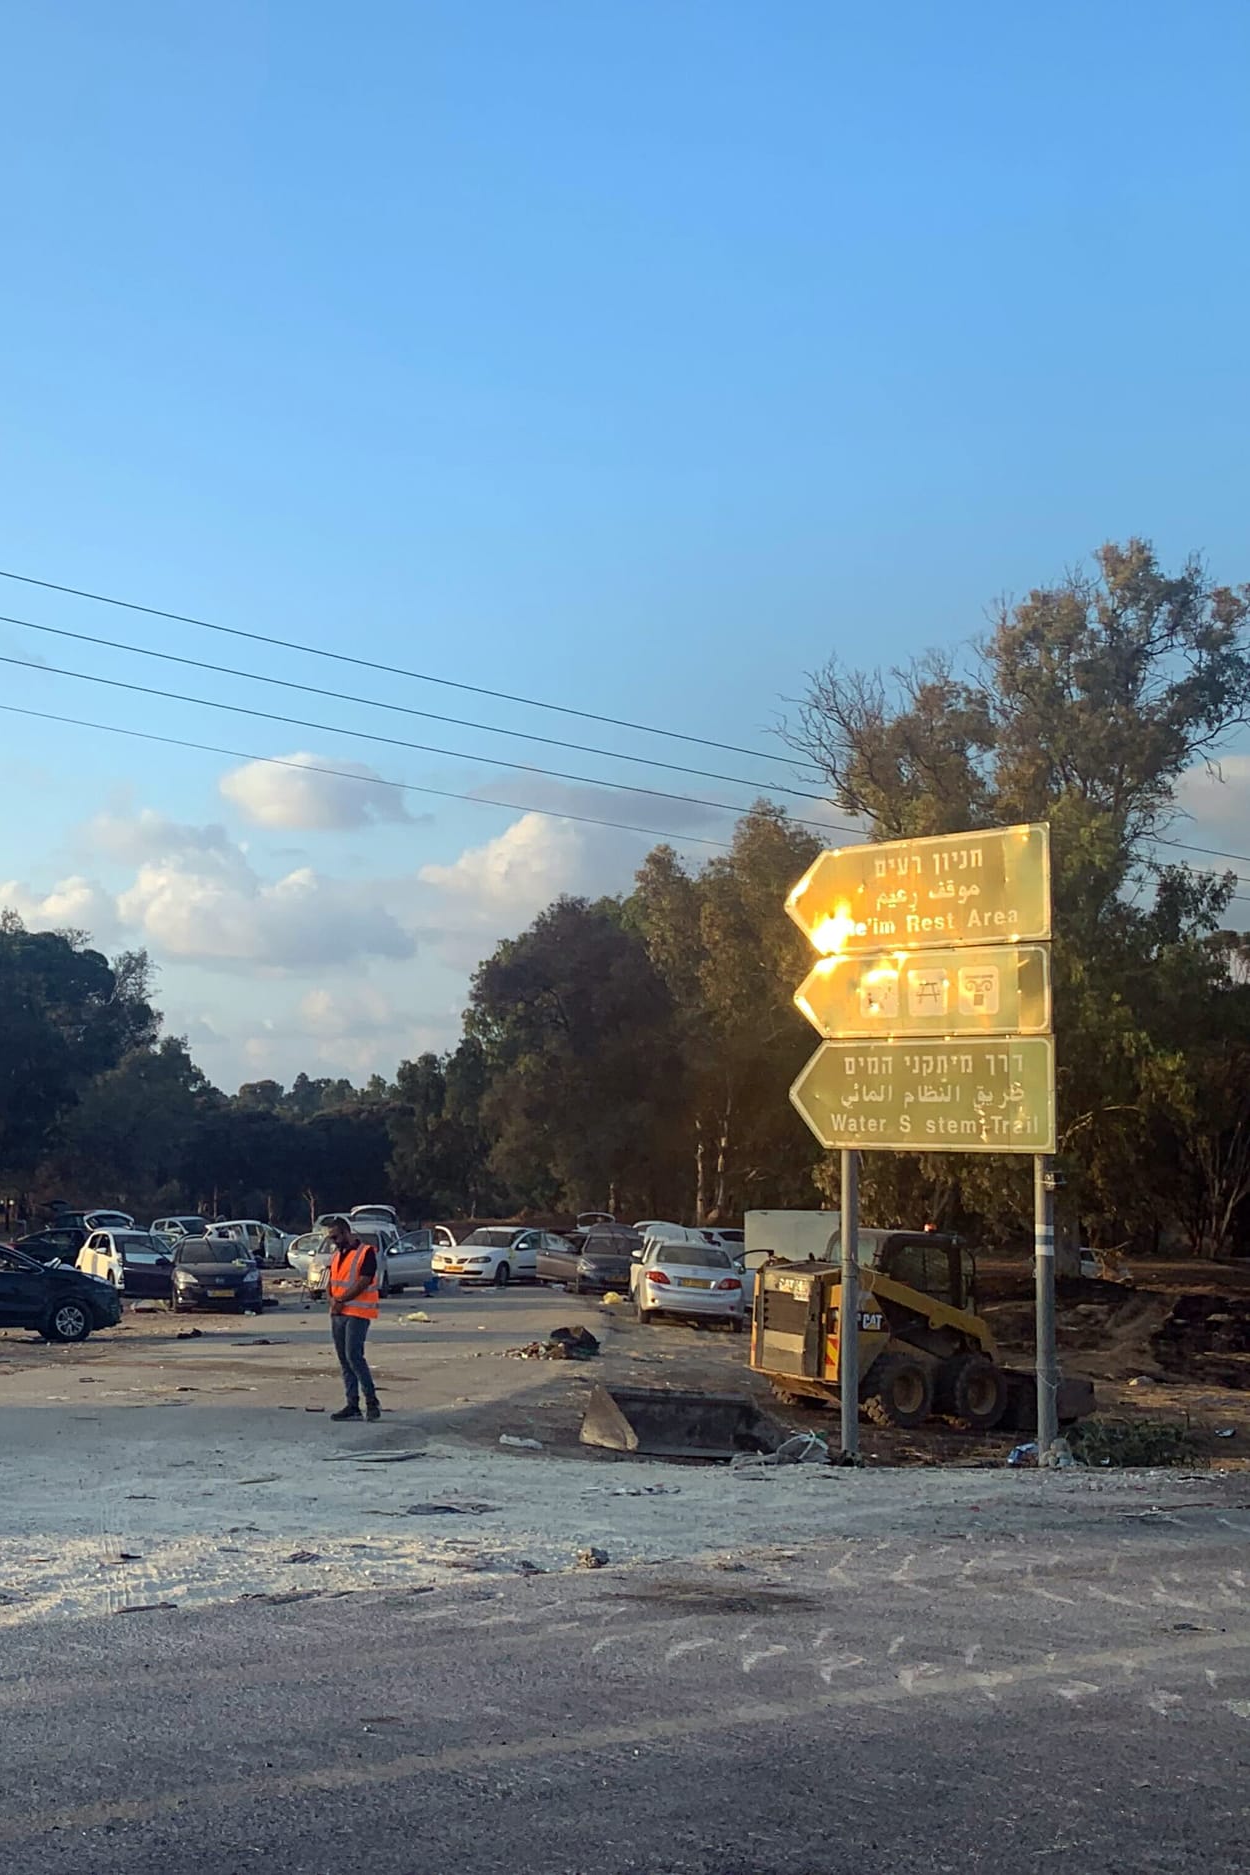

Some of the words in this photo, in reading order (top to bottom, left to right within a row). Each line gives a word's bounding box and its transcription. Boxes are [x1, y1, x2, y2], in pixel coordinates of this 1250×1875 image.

[874, 855, 922, 878] רעים
[932, 848, 982, 876] חניון
[928, 879, 981, 904] موقف
[842, 917, 895, 937] e'im
[906, 911, 955, 934] Rest
[967, 908, 1018, 928] Area
[843, 1056, 893, 1075] המים
[903, 1054, 973, 1077] מיתקני
[984, 1053, 1023, 1076] דרך
[841, 1082, 892, 1109] المائي
[904, 1084, 960, 1109] النظام
[830, 1113, 887, 1132] Water
[899, 1114, 977, 1134] Sstem
[990, 1114, 1038, 1134] Trail
[862, 1313, 883, 1330] CAT
